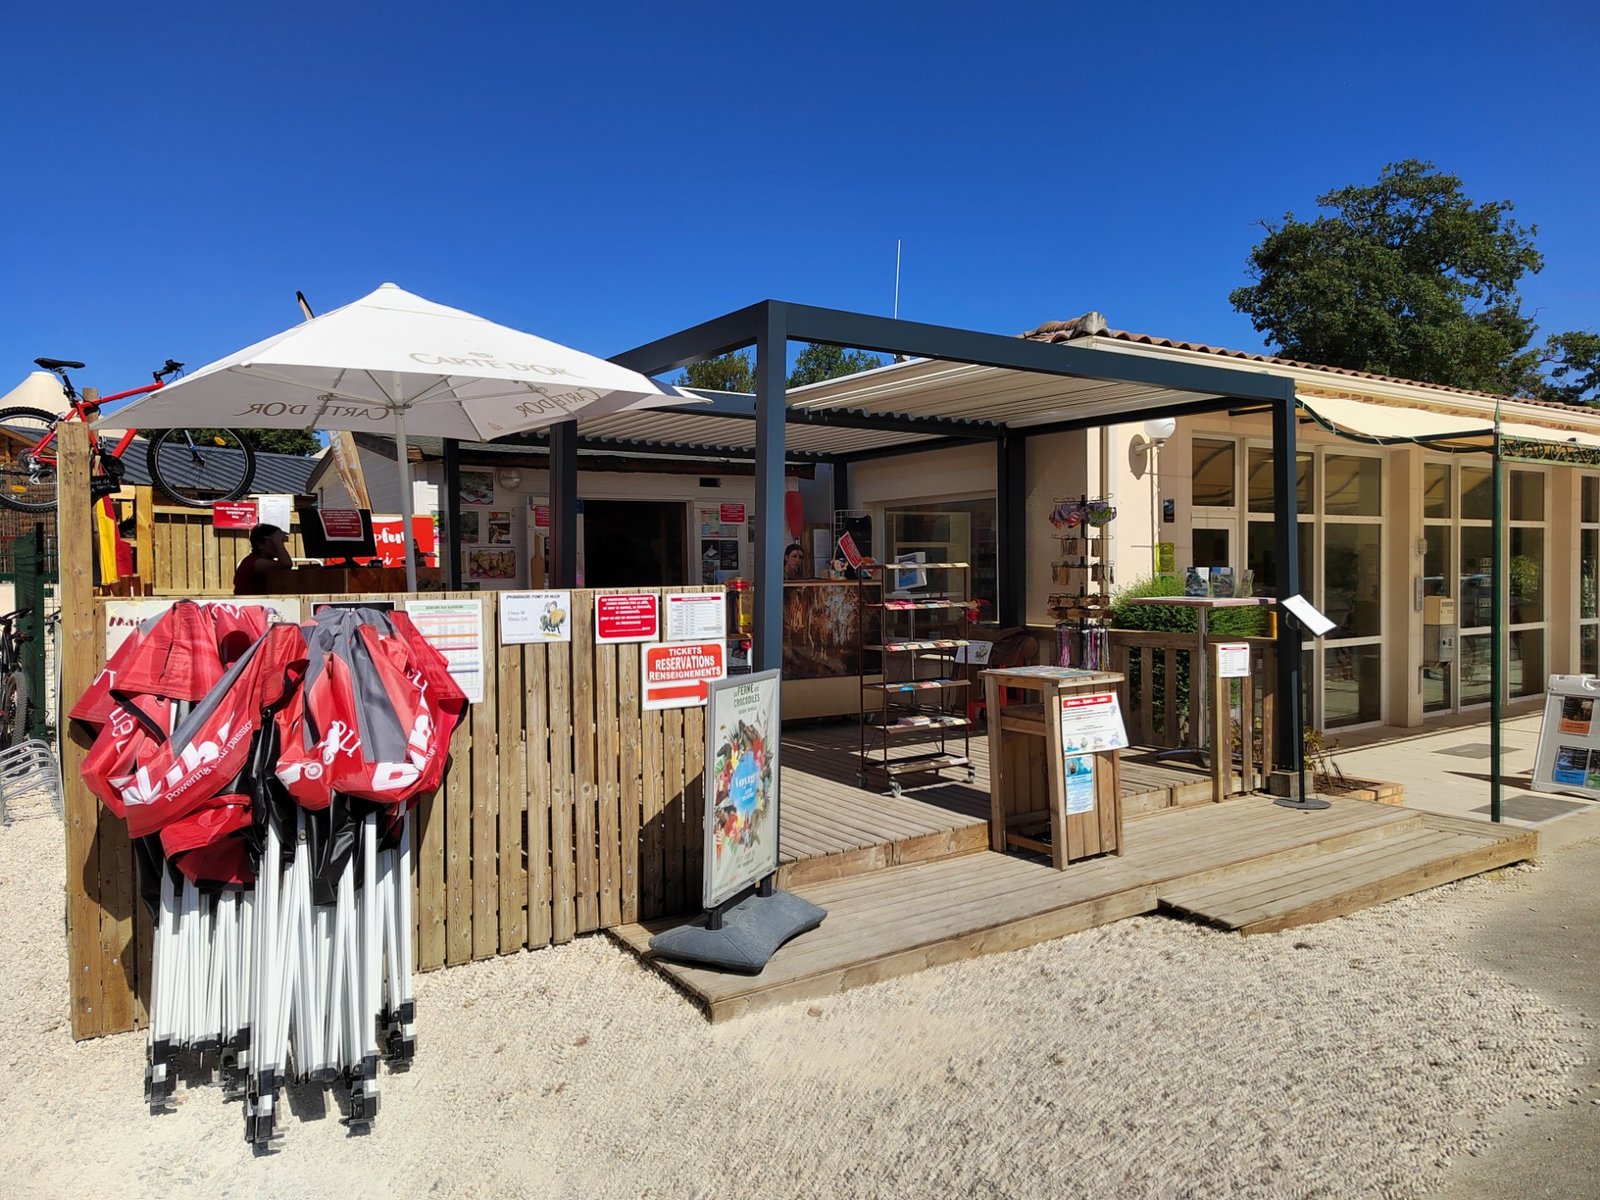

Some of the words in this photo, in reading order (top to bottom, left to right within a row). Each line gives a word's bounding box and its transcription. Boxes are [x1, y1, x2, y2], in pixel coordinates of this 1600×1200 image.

[410, 352, 500, 371] CARTE
[508, 361, 584, 379] D'OR
[668, 646, 702, 657] TICKETS
[655, 655, 715, 671] RESERVATIONS
[649, 666, 721, 681] RENSEIGNEMENTS
[737, 683, 754, 696] FERME
[733, 693, 760, 708] CROCODILES
[165, 767, 212, 802] Powering
[227, 719, 254, 749] passio
